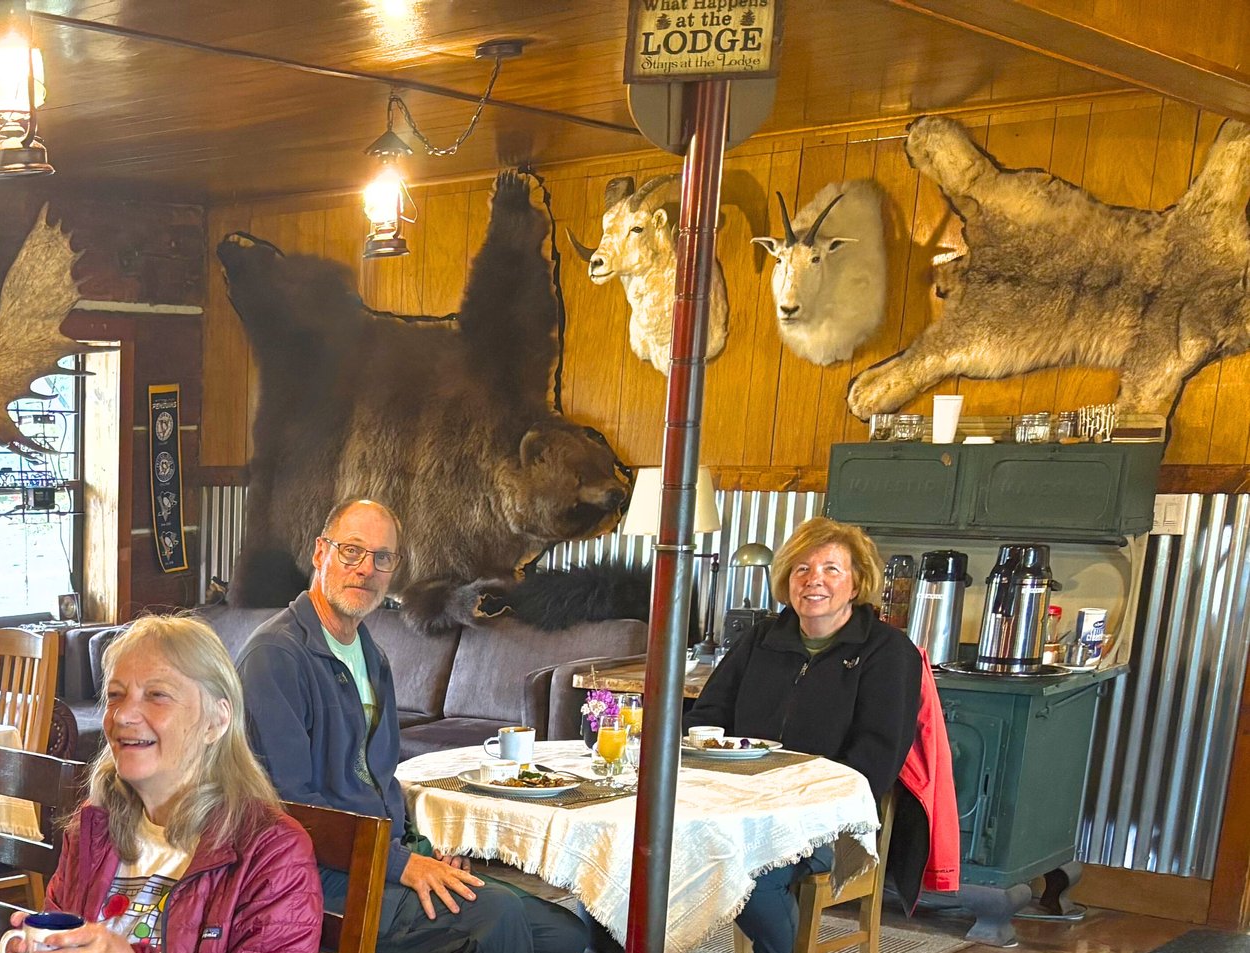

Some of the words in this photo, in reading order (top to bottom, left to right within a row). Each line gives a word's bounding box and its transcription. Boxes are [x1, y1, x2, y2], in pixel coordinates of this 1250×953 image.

[644, 0, 688, 11] What
[693, 0, 768, 12] Happens
[675, 12, 695, 28] at
[701, 11, 732, 27] the
[640, 27, 763, 56] LODGE
[641, 56, 678, 72] Stays
[680, 56, 692, 68] at
[695, 55, 715, 68] the
[716, 53, 761, 70] Lodge
